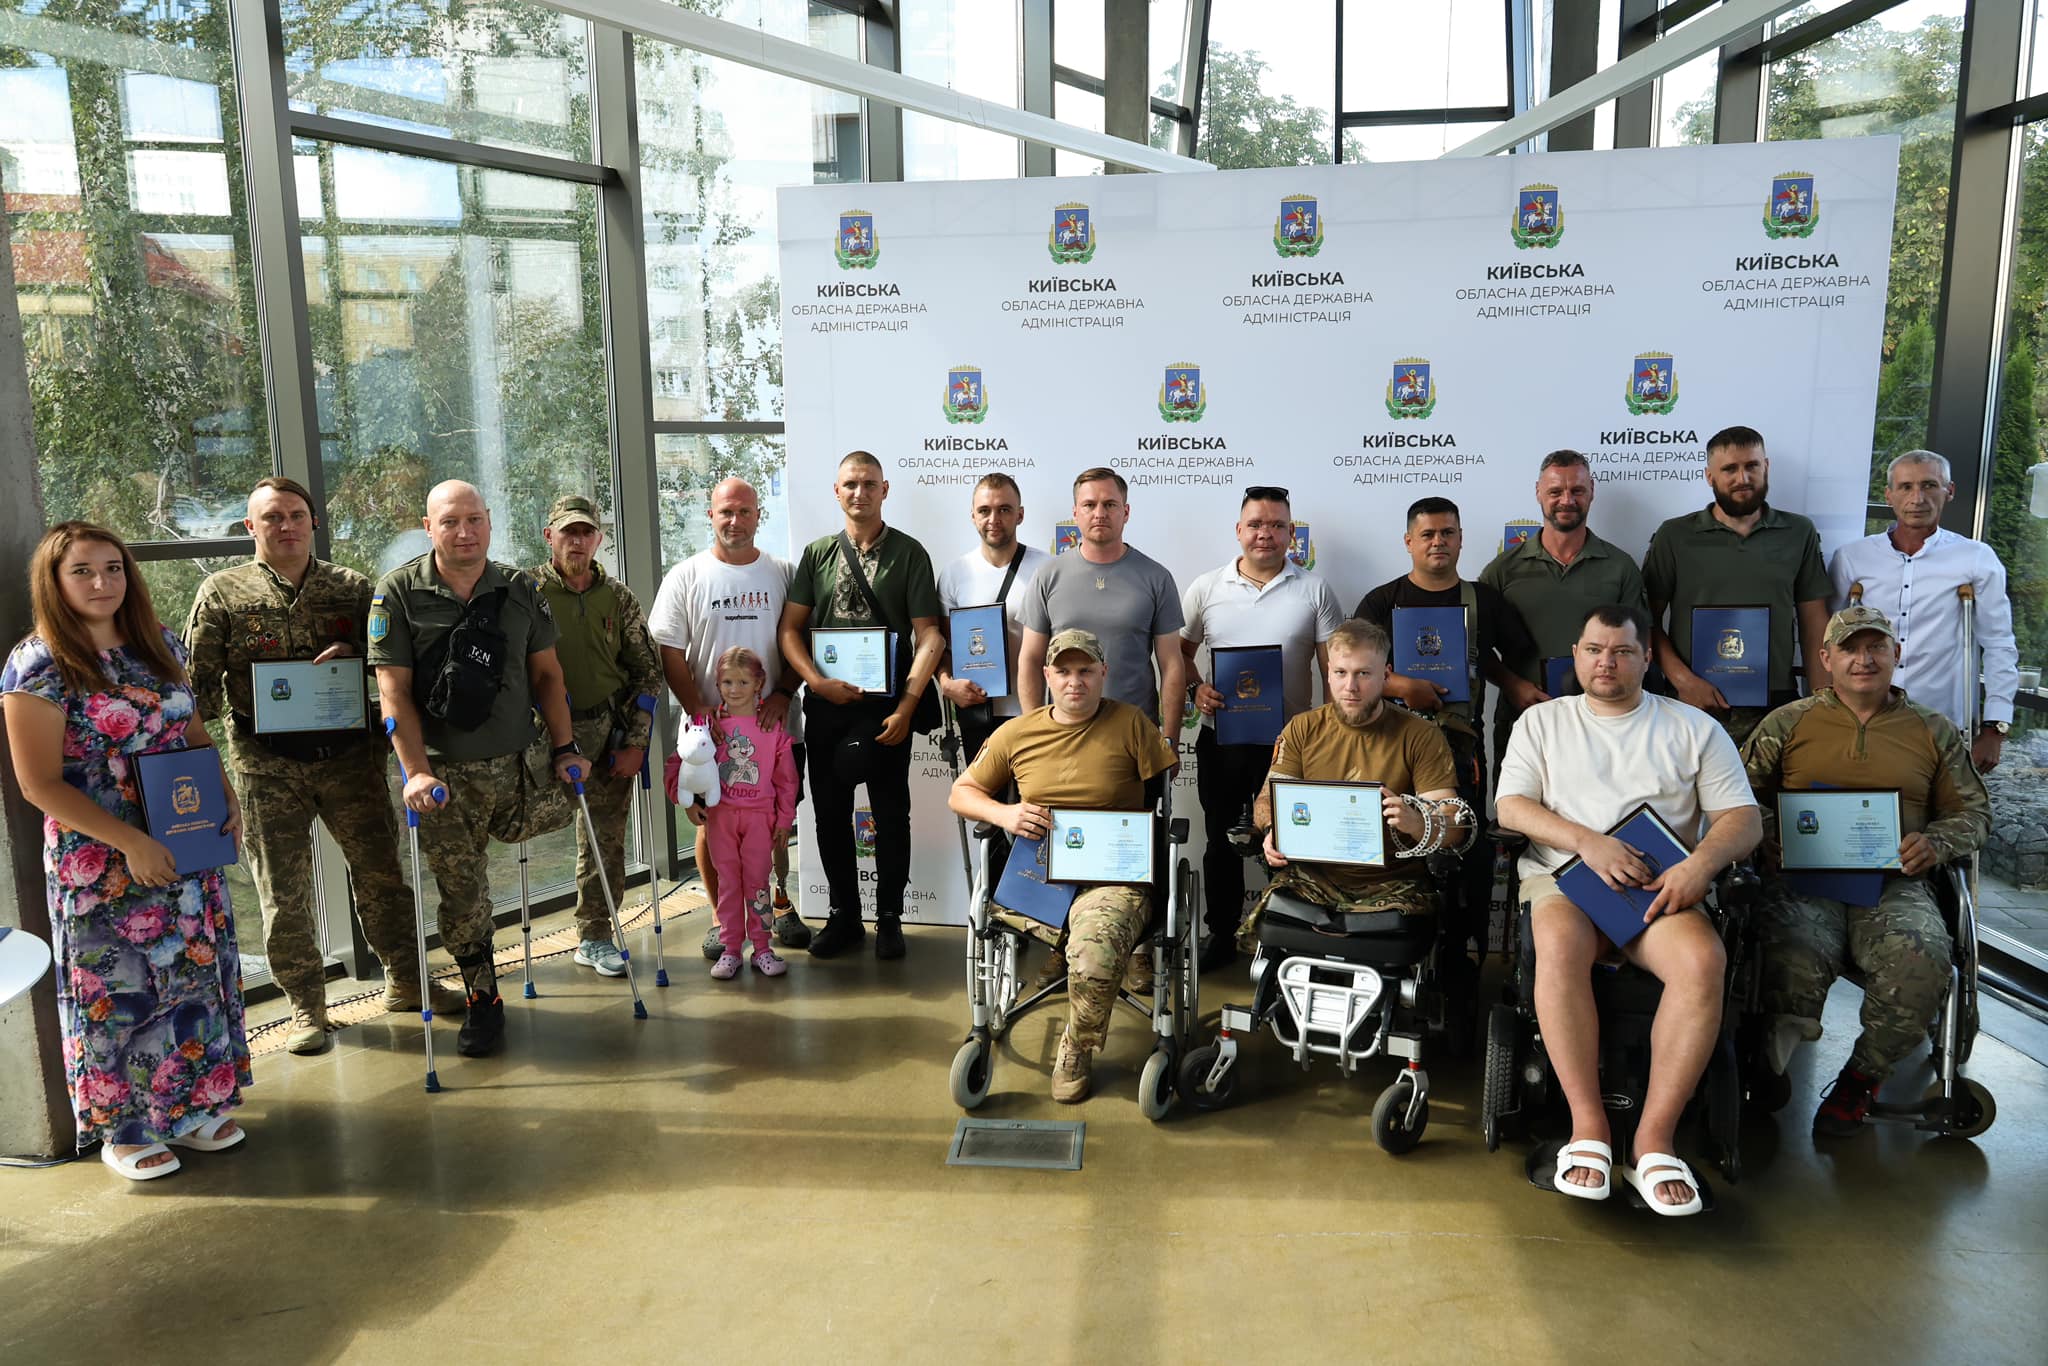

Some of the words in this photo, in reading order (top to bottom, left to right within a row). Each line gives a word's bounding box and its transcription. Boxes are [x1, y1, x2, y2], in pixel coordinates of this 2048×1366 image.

[1736, 252, 1839, 271] КИЇВСЬКА
[1252, 270, 1344, 287] КИЇВСЬКА
[1487, 262, 1584, 280] КИЇВСЬКА
[817, 281, 901, 298] КИЇВСЬКА
[1029, 276, 1117, 293] КИЇВСЬКА
[1702, 278, 1777, 292] ОБЛАСНА
[1781, 275, 1870, 291] ДЕРЖАВНА
[1223, 295, 1290, 306] ОБЛАСНА
[1293, 292, 1373, 307] ДЕРЖАВНА
[1456, 288, 1527, 300] ОБЛАСНА
[1530, 284, 1615, 299] ДЕРЖАВНА
[792, 304, 853, 316] ОБЛАСНА
[857, 304, 927, 316] ДЕРЖАВНА
[1002, 300, 1066, 311] ОБЛАСНА
[1068, 298, 1144, 312] ДЕРЖАВНА
[1724, 295, 1844, 311] АДМІНІСТРАЦІЯ
[1243, 311, 1351, 326] АДМІНІСТРАЦІЯ
[1477, 304, 1590, 319] АДМІНІСТРАЦІЯ
[811, 320, 908, 333] АДМІНІСТРАЦІЯ
[1021, 316, 1123, 330] АДМІНІСТРАЦІЯ
[924, 435, 1008, 451] КИЇВСЬКА
[1138, 434, 1227, 450] КИЇВСЬКА
[1363, 432, 1456, 448] КИЇВСЬКА
[1600, 428, 1699, 445] КИЇВСЬКА
[898, 458, 960, 468] ОБЛАСНА
[962, 457, 1035, 469] ДЕРЖАВНА
[1110, 457, 1175, 469] ОБЛАСНА
[1177, 457, 1254, 469] ДЕРЖАВНА
[1333, 456, 1400, 467] ОБЛАСНА
[1404, 454, 1485, 467] ДЕРЖАВНА
[1583, 452, 1640, 463] ЛАСНА
[1643, 451, 1707, 464] ДЕРЖАВ
[917, 474, 1015, 486] АДМІНІСТ
[1129, 474, 1232, 486] АДМІНІСТРАЦІЯ
[1353, 472, 1462, 485] АДМІНІСТРАЦІЯ
[1590, 469, 1704, 483] АДМІНІСТРАЦІЯ
